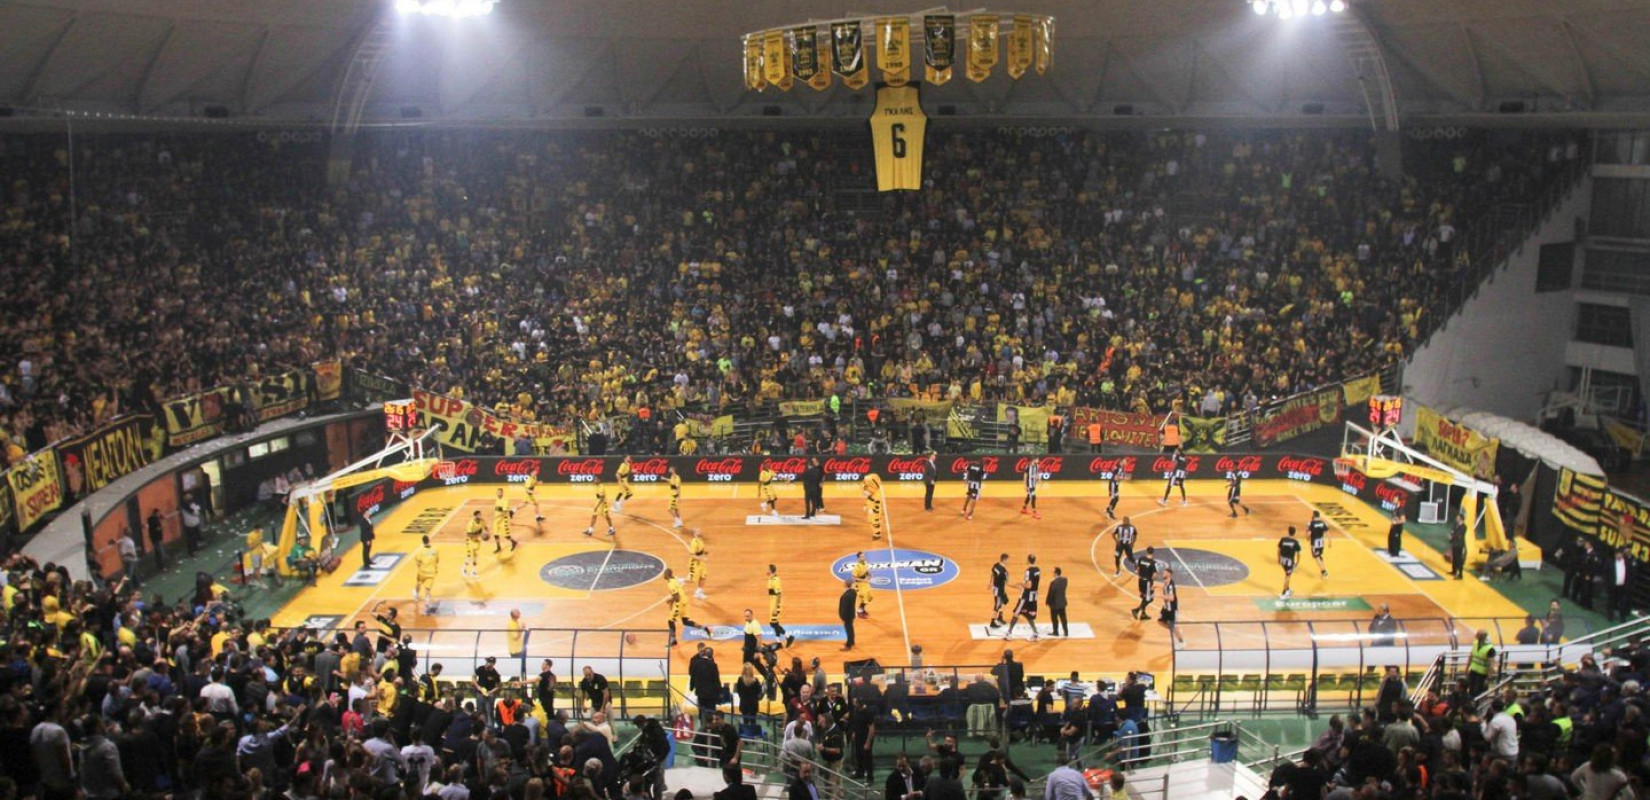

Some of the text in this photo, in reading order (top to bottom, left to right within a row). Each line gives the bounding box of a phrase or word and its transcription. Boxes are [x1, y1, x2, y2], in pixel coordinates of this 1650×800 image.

[891, 123, 907, 158] 6
[387, 415, 404, 428] 24
[1385, 411, 1401, 425] 24
[444, 475, 469, 486] zero
[570, 474, 594, 482] zero
[633, 474, 657, 482] zero
[708, 473, 732, 481] zero
[899, 472, 923, 480] zero
[1288, 470, 1311, 482] zero
